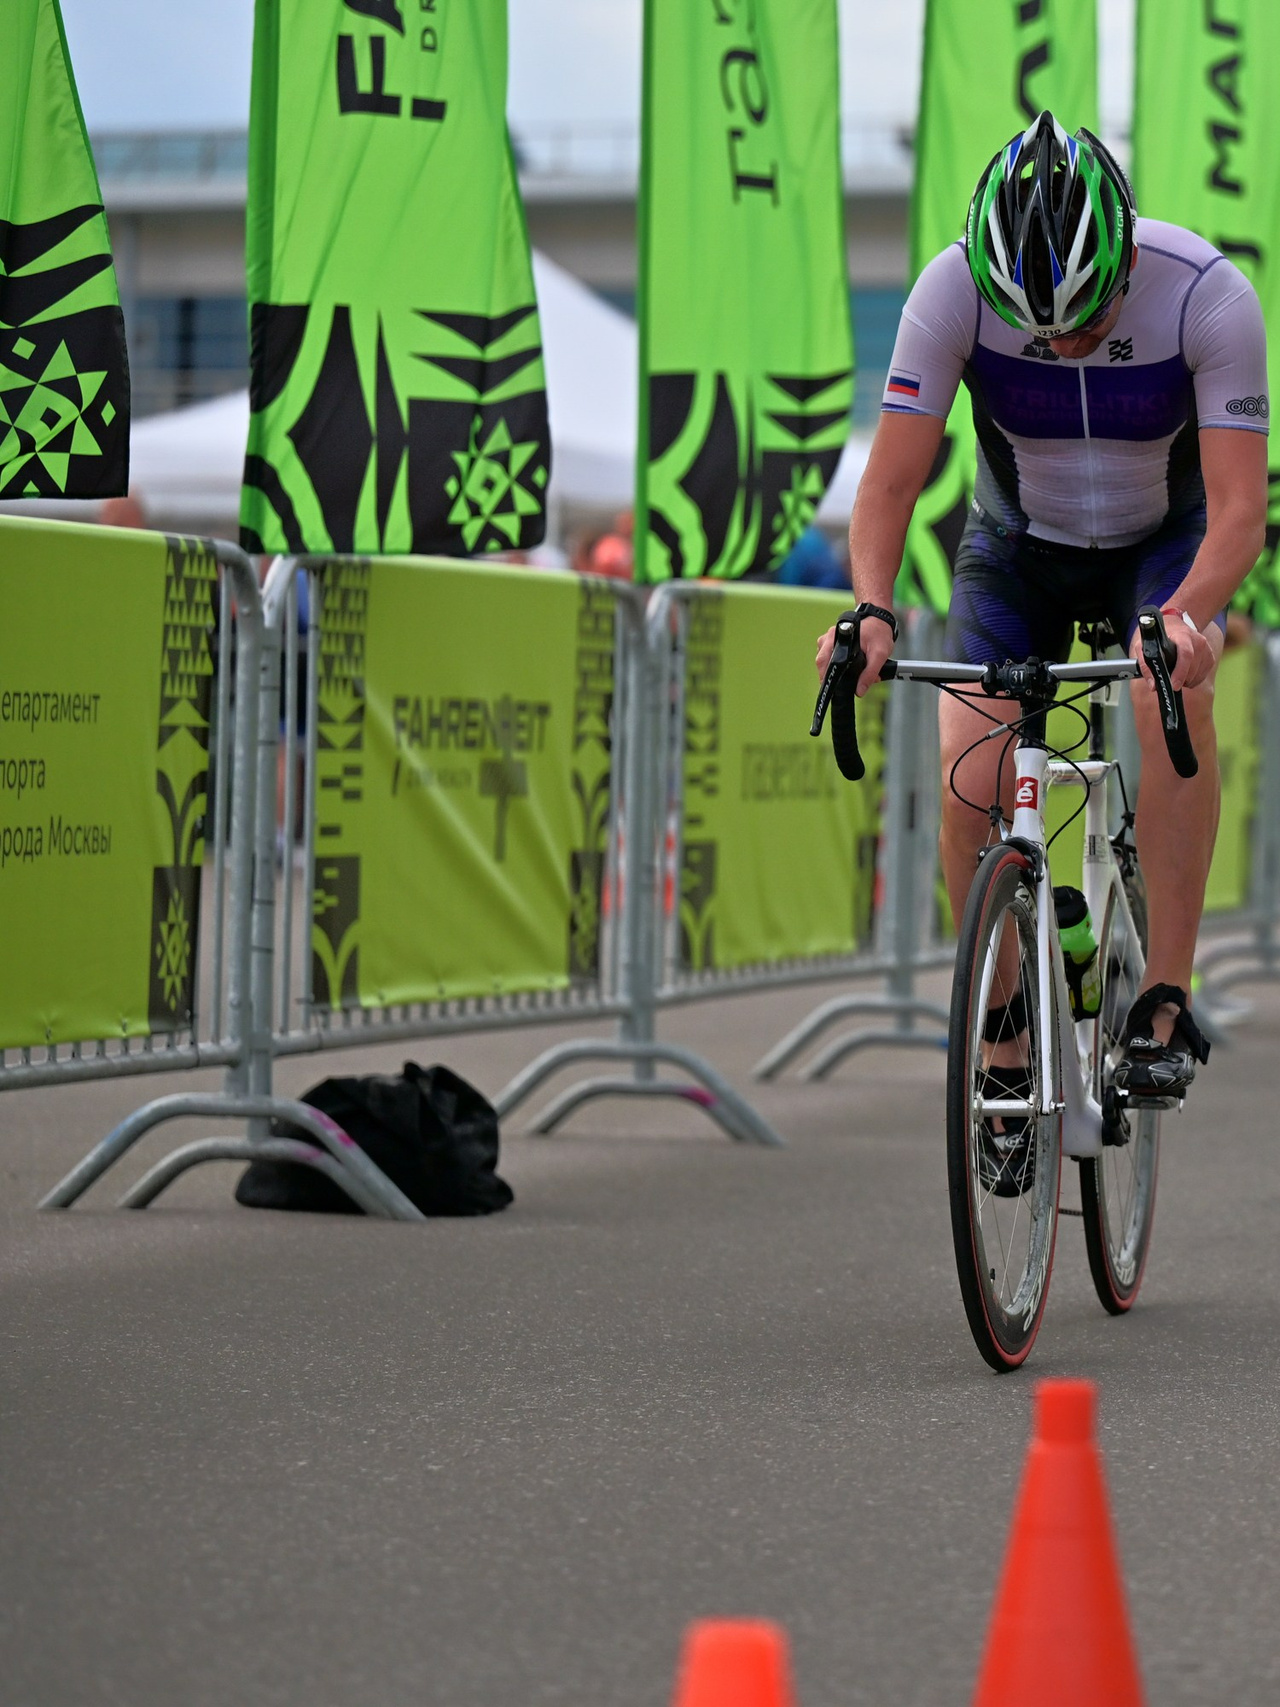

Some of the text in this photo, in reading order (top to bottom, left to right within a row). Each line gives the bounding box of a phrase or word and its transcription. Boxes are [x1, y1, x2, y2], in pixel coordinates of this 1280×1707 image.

[1038, 328, 1062, 338] 1230
[0, 814, 112, 868] рода Москвы
